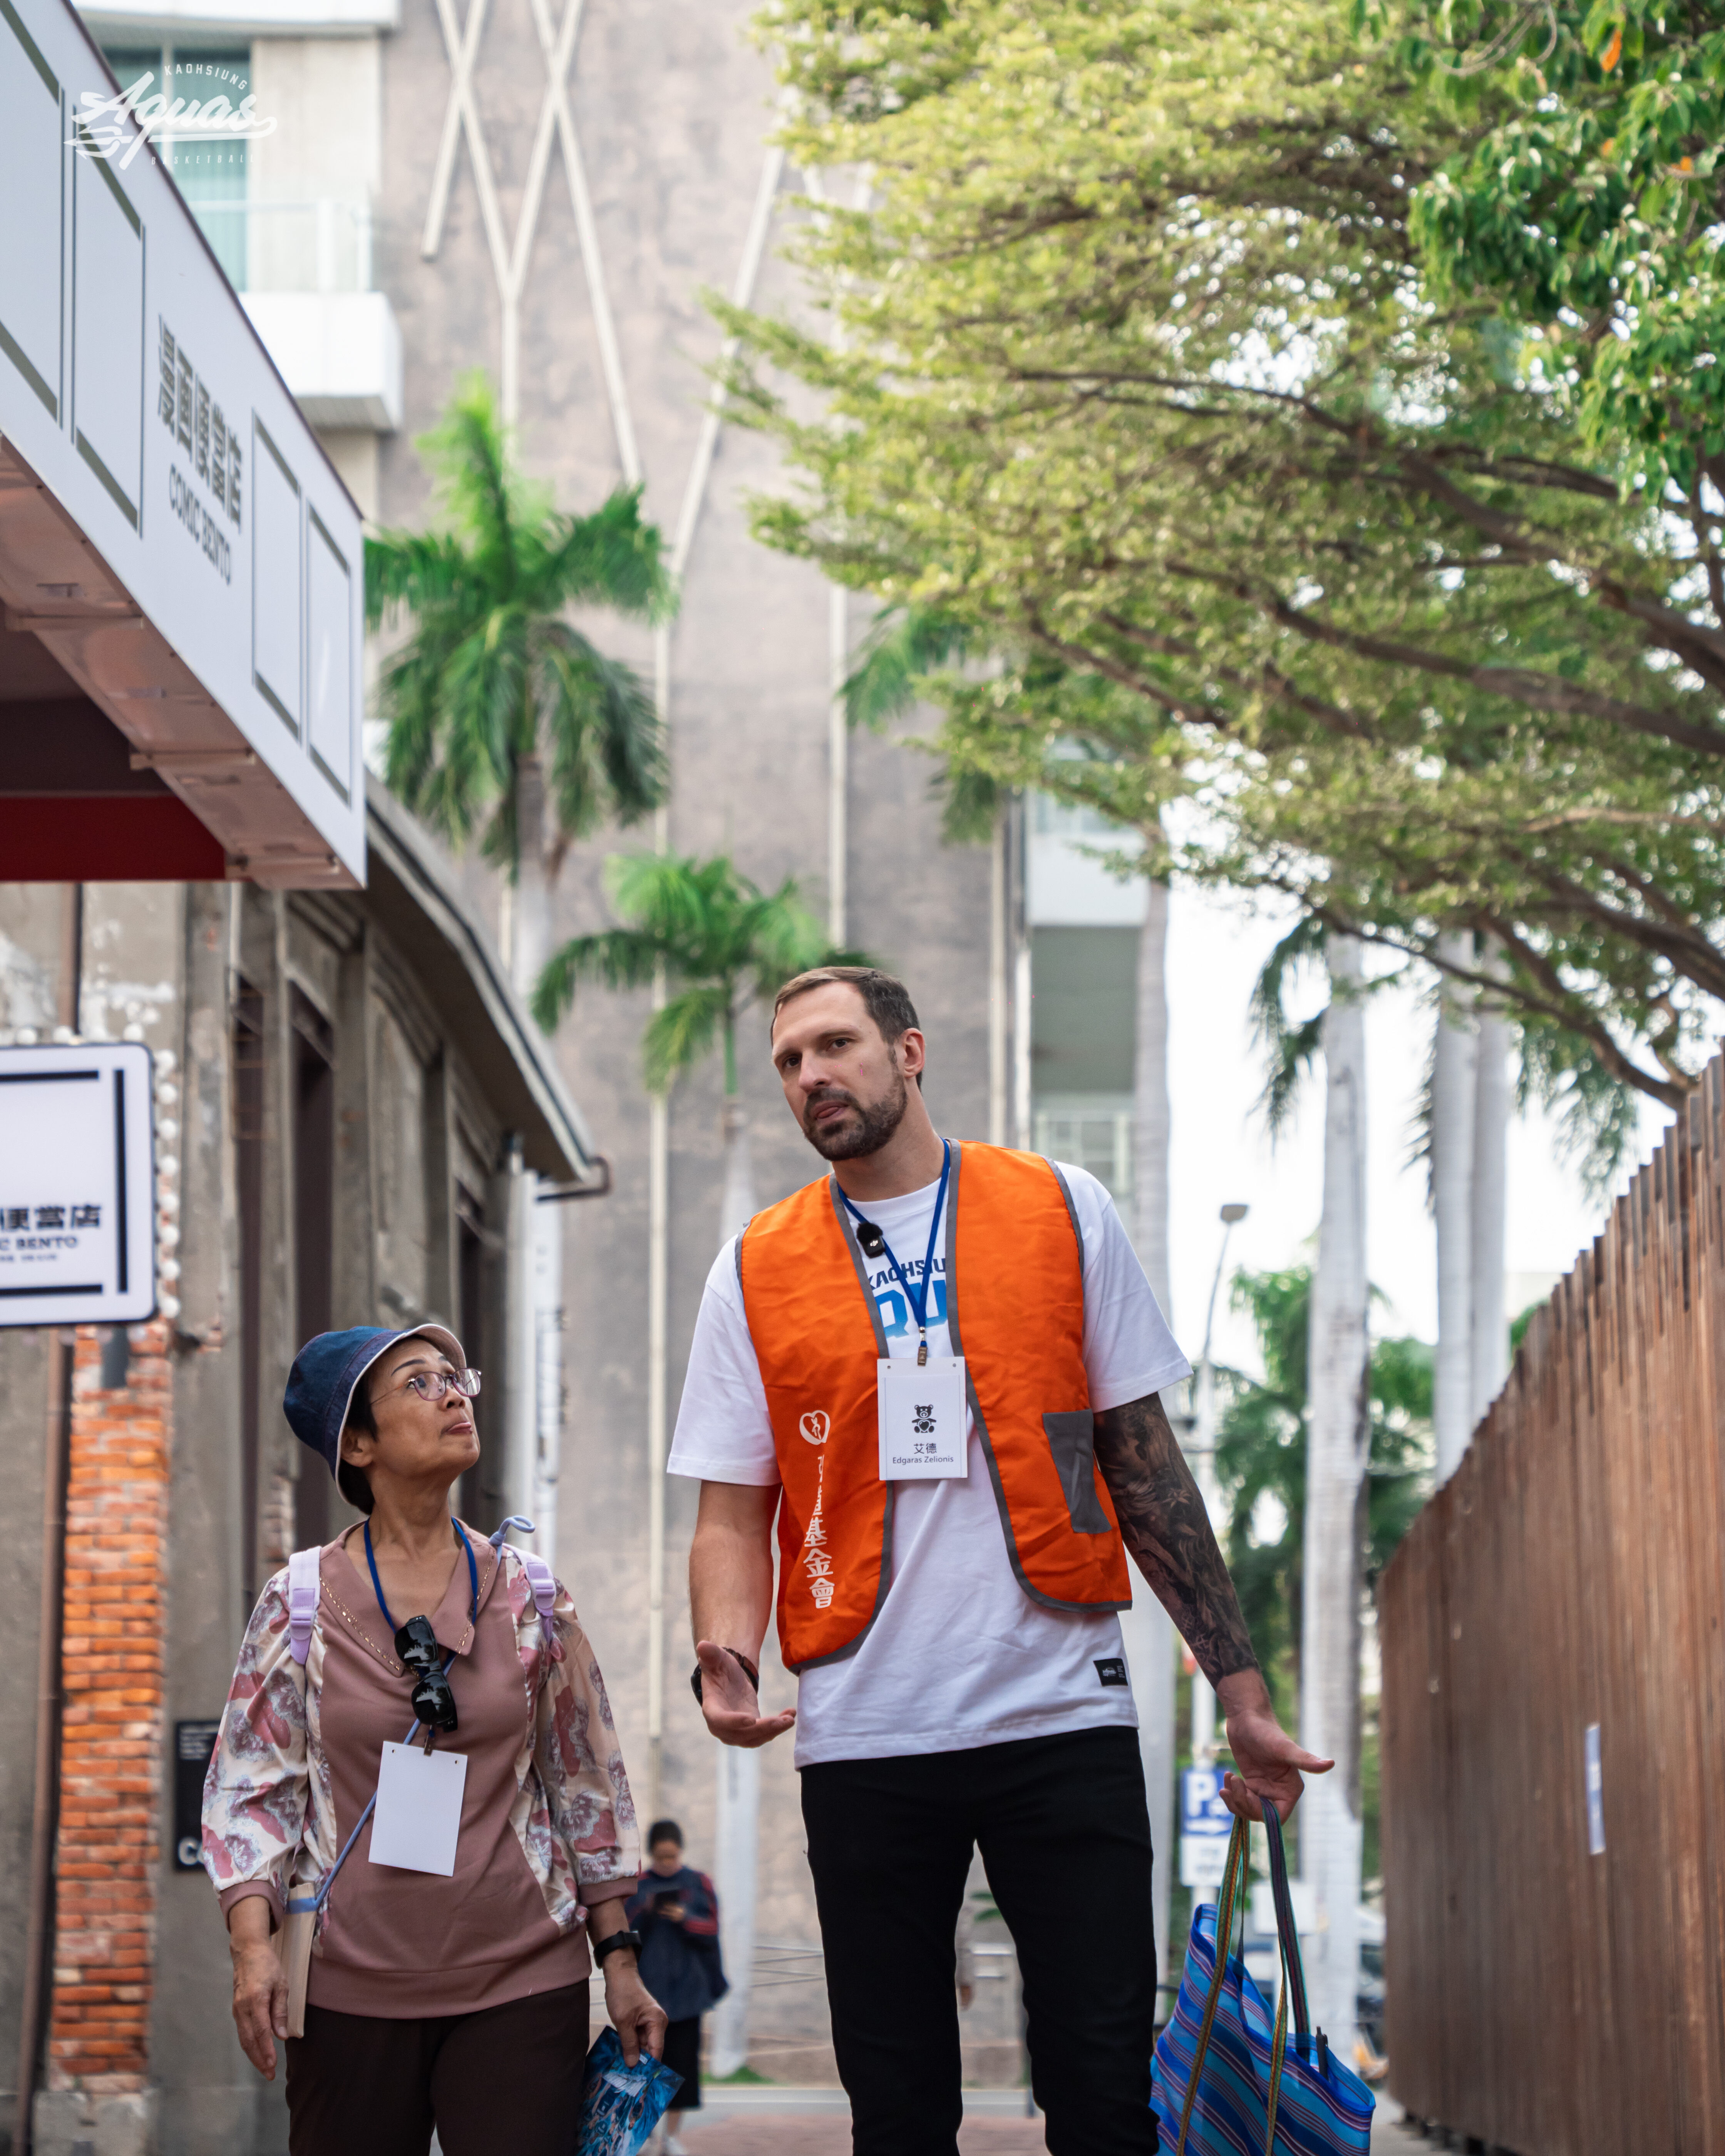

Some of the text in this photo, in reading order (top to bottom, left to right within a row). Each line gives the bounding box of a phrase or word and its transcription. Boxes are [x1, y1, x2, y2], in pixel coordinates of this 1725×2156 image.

[169, 463, 231, 586] COMIC BENTO
[16, 1237, 78, 1250] BENTO
[914, 1443, 937, 1454] 艾德
[893, 1456, 922, 1465] Edgaras
[1187, 1773, 1216, 1817] P
